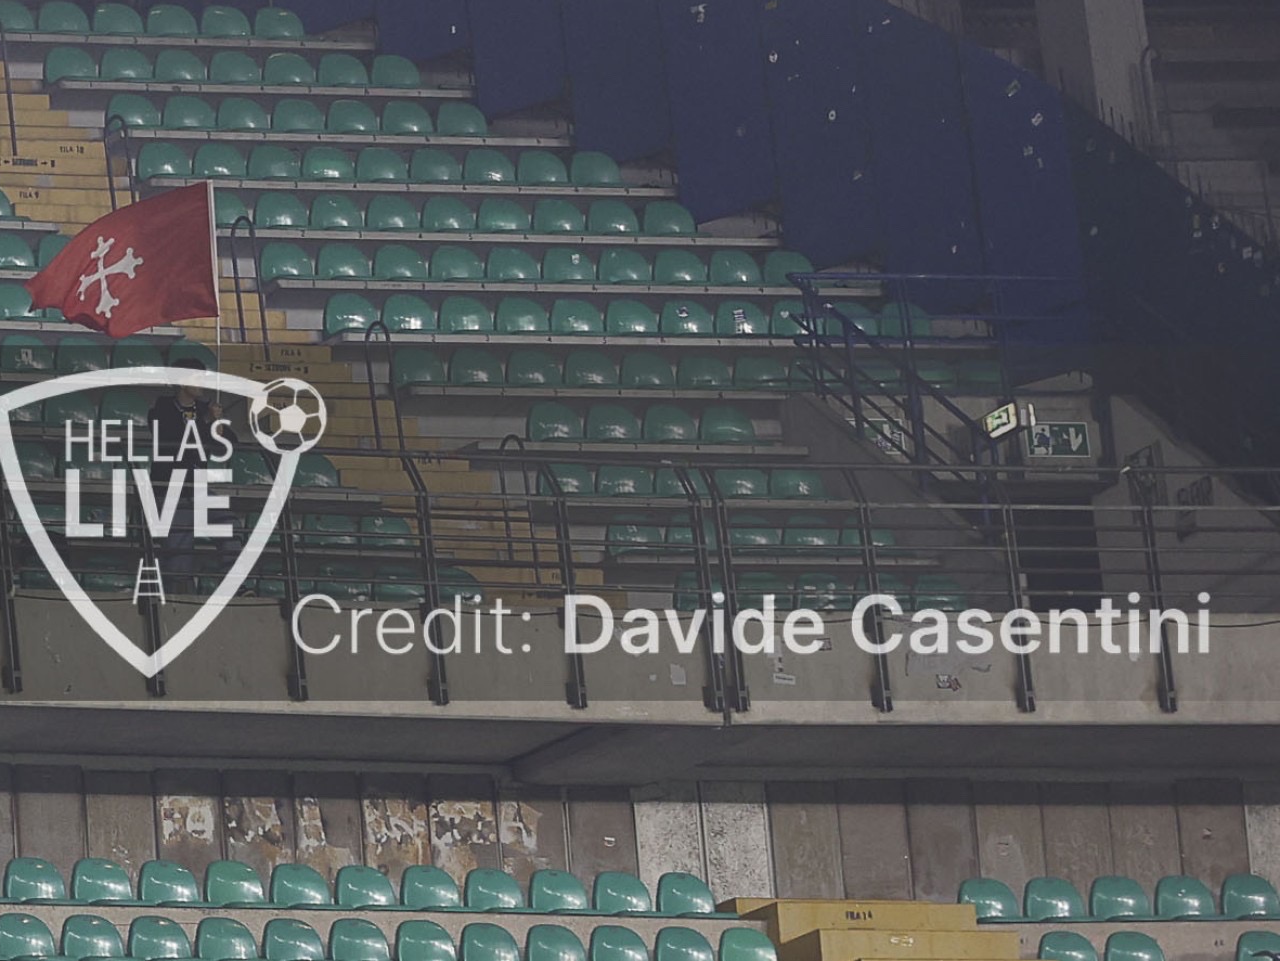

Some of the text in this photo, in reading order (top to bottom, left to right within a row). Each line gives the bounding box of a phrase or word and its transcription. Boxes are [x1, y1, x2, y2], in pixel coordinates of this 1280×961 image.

[59, 145, 74, 154] FILA
[19, 191, 32, 199] FILA
[845, 910, 862, 921] FILA
